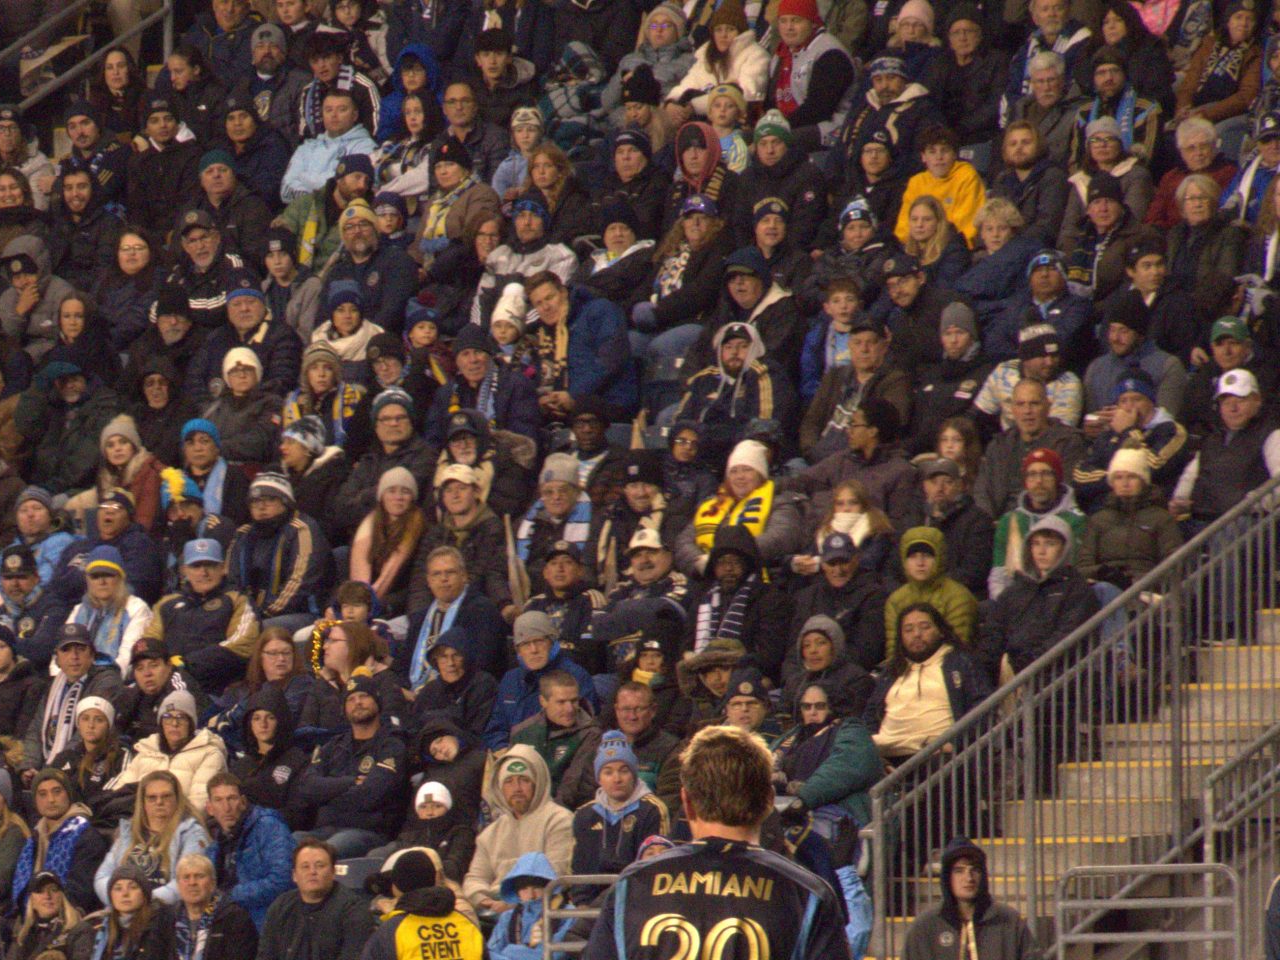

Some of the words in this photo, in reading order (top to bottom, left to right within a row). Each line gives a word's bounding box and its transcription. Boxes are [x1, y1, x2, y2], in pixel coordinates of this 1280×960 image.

[652, 870, 775, 902] DAMIANI
[417, 922, 459, 941] CSC
[420, 940, 461, 960] EVENT
